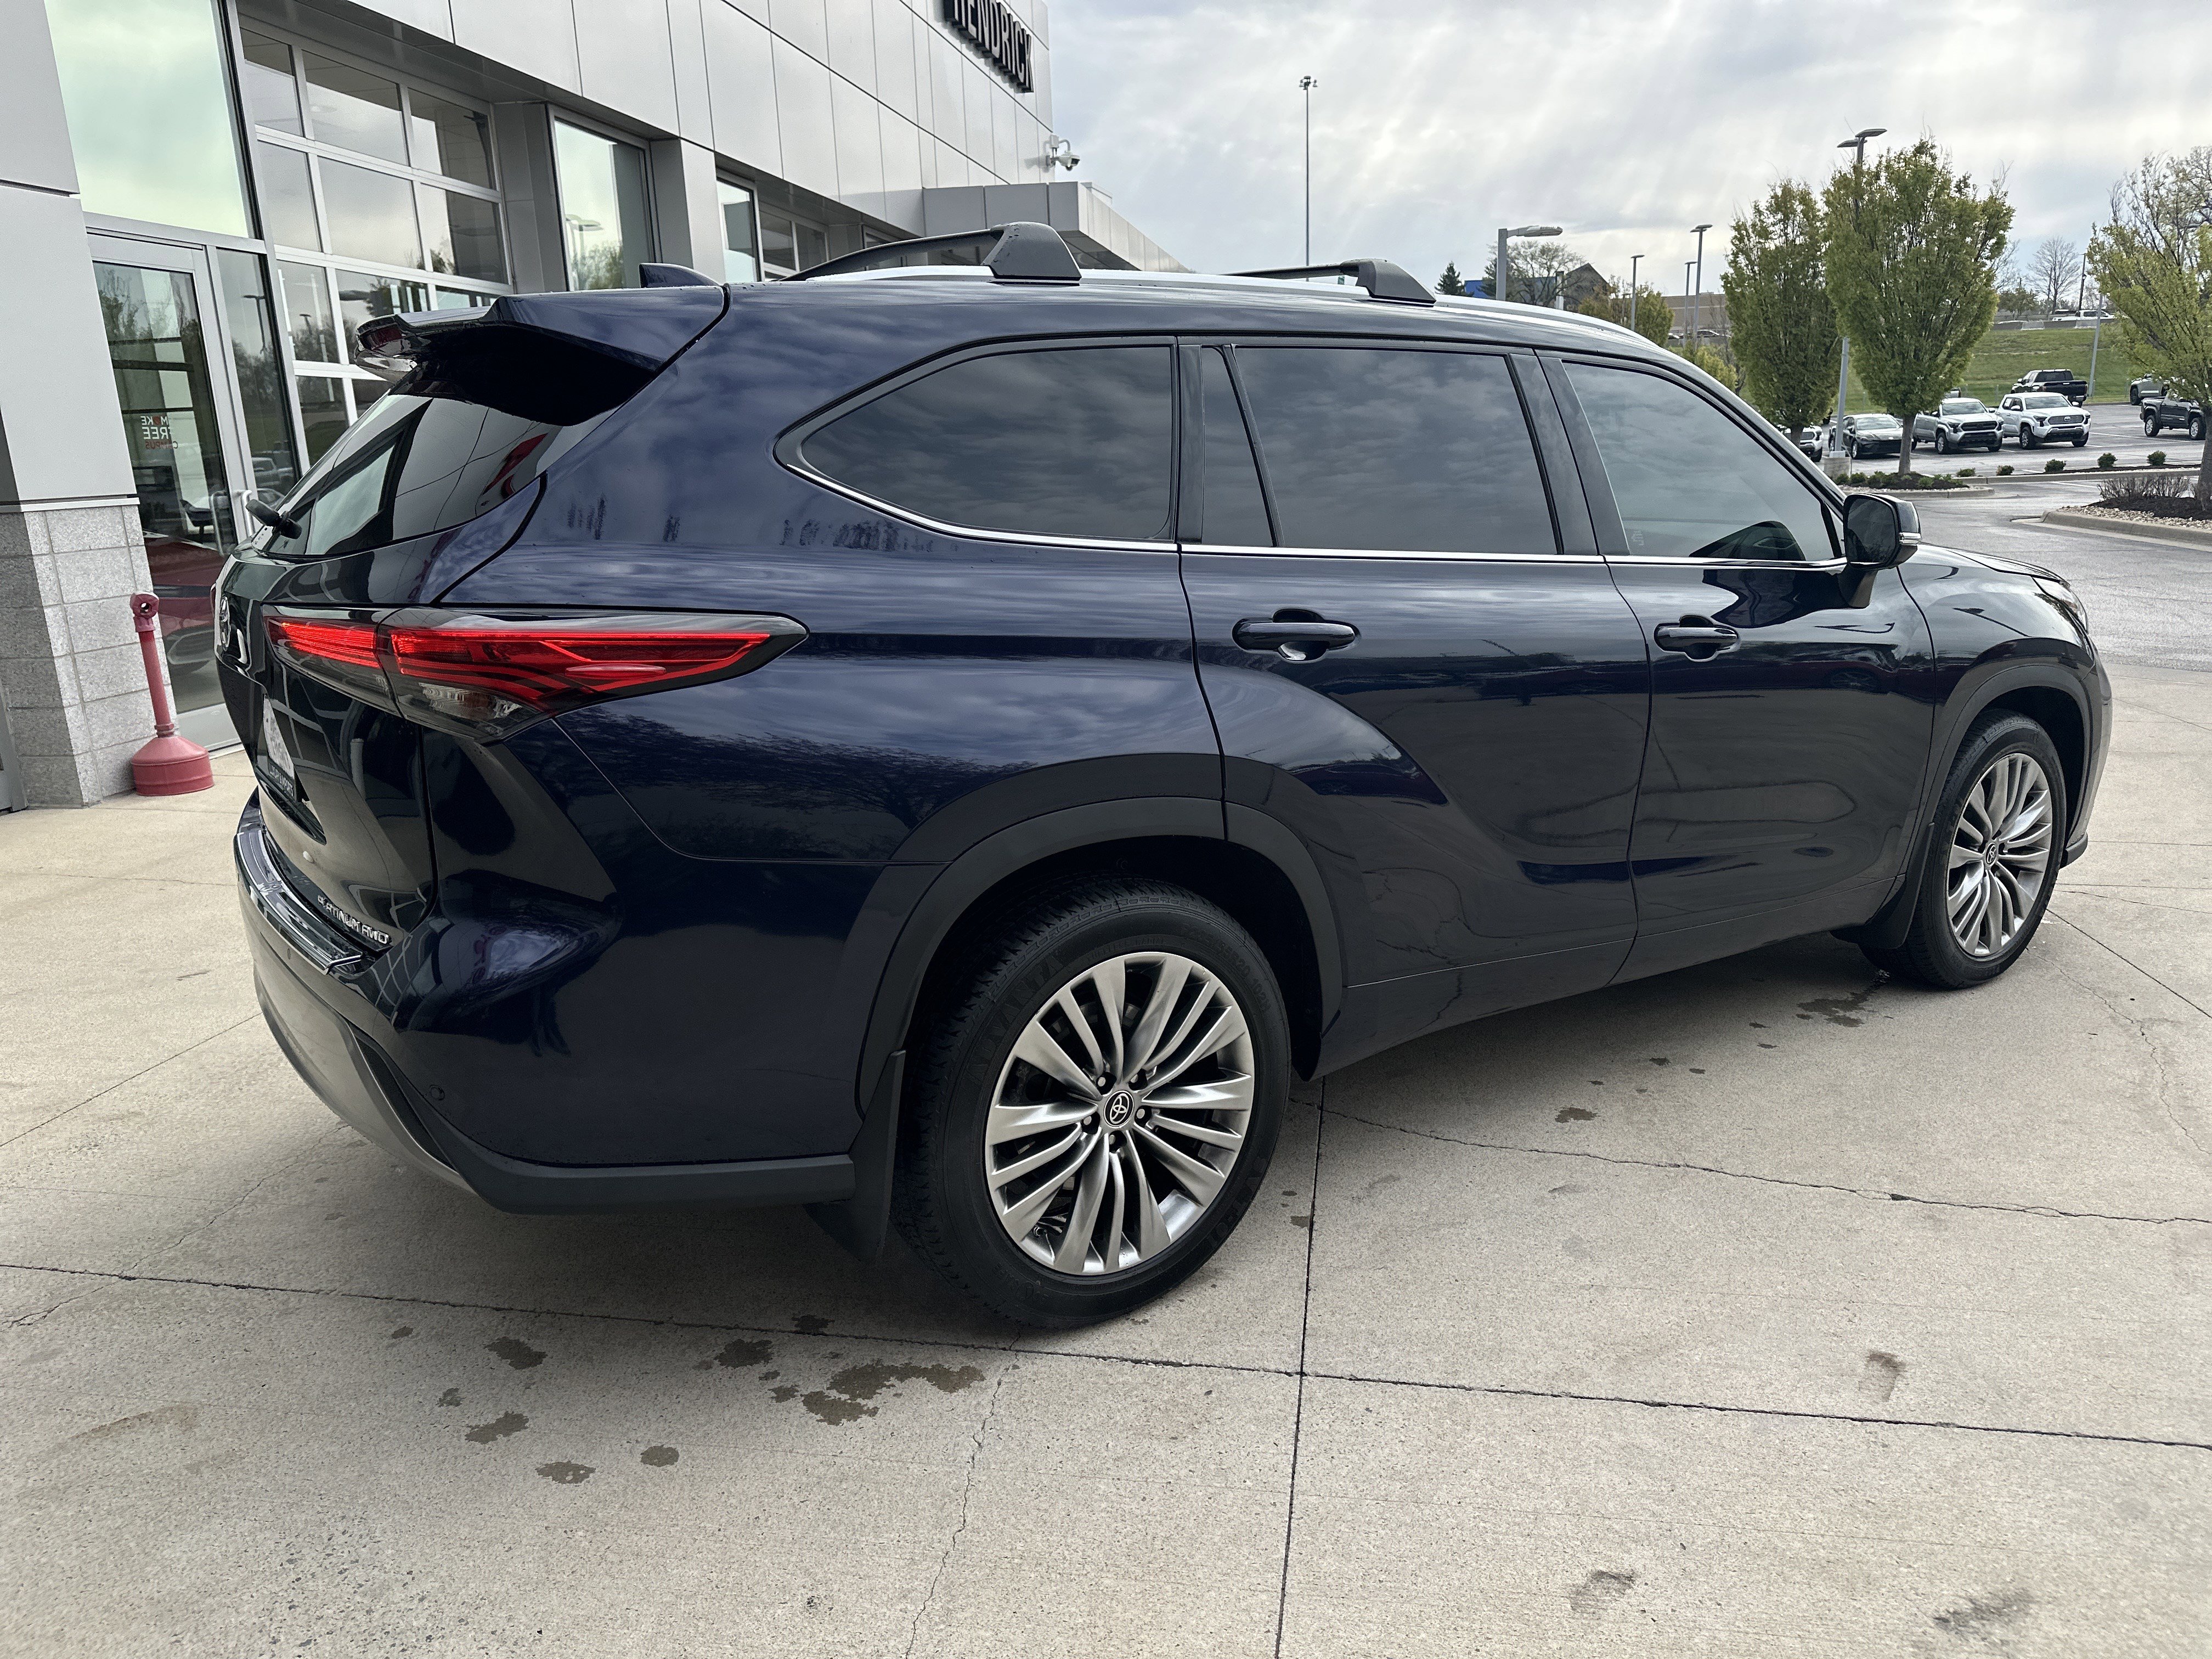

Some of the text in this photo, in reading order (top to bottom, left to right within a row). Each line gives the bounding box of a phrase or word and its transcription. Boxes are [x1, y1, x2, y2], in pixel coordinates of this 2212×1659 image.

[317, 894, 389, 944] PLATINUM AWD
[966, 954, 1065, 1085] ADVANTA
